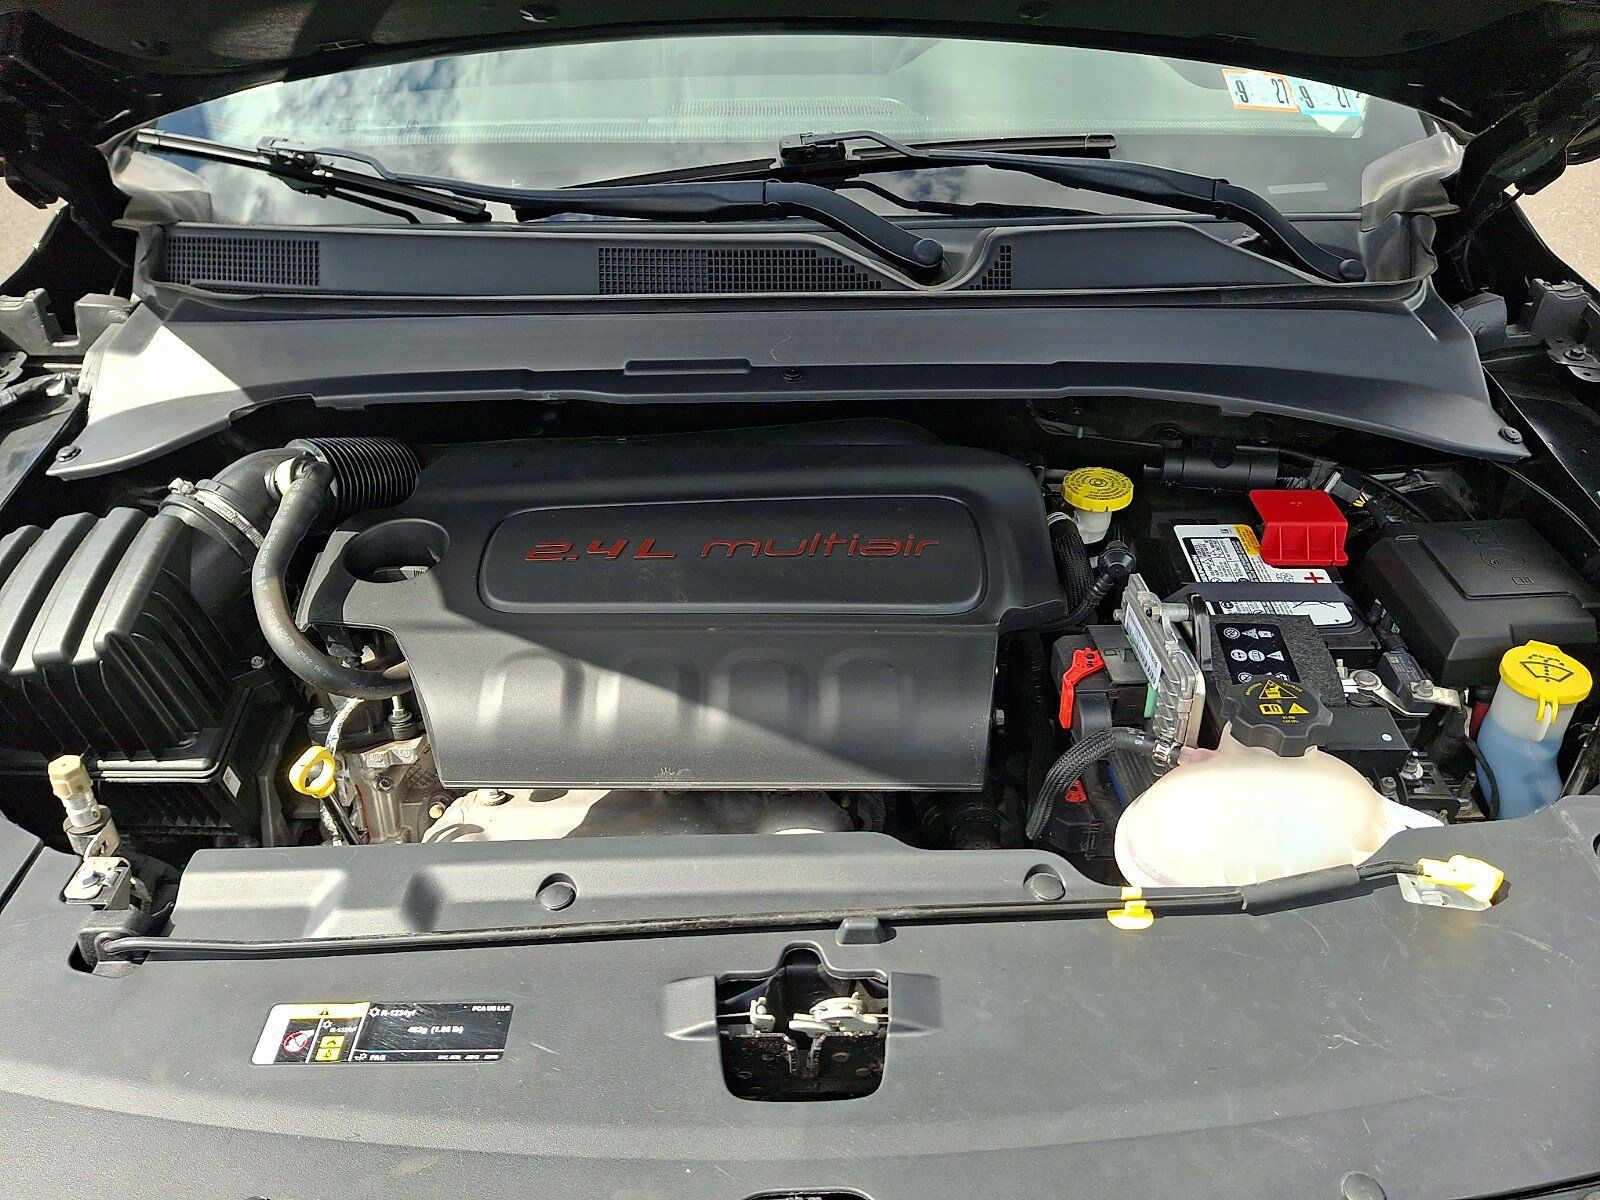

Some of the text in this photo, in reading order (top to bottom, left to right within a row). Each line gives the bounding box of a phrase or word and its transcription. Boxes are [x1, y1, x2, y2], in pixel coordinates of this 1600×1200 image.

[1235, 79, 1249, 103] 9
[1298, 85, 1315, 109] 9
[700, 533, 940, 558] multiair
